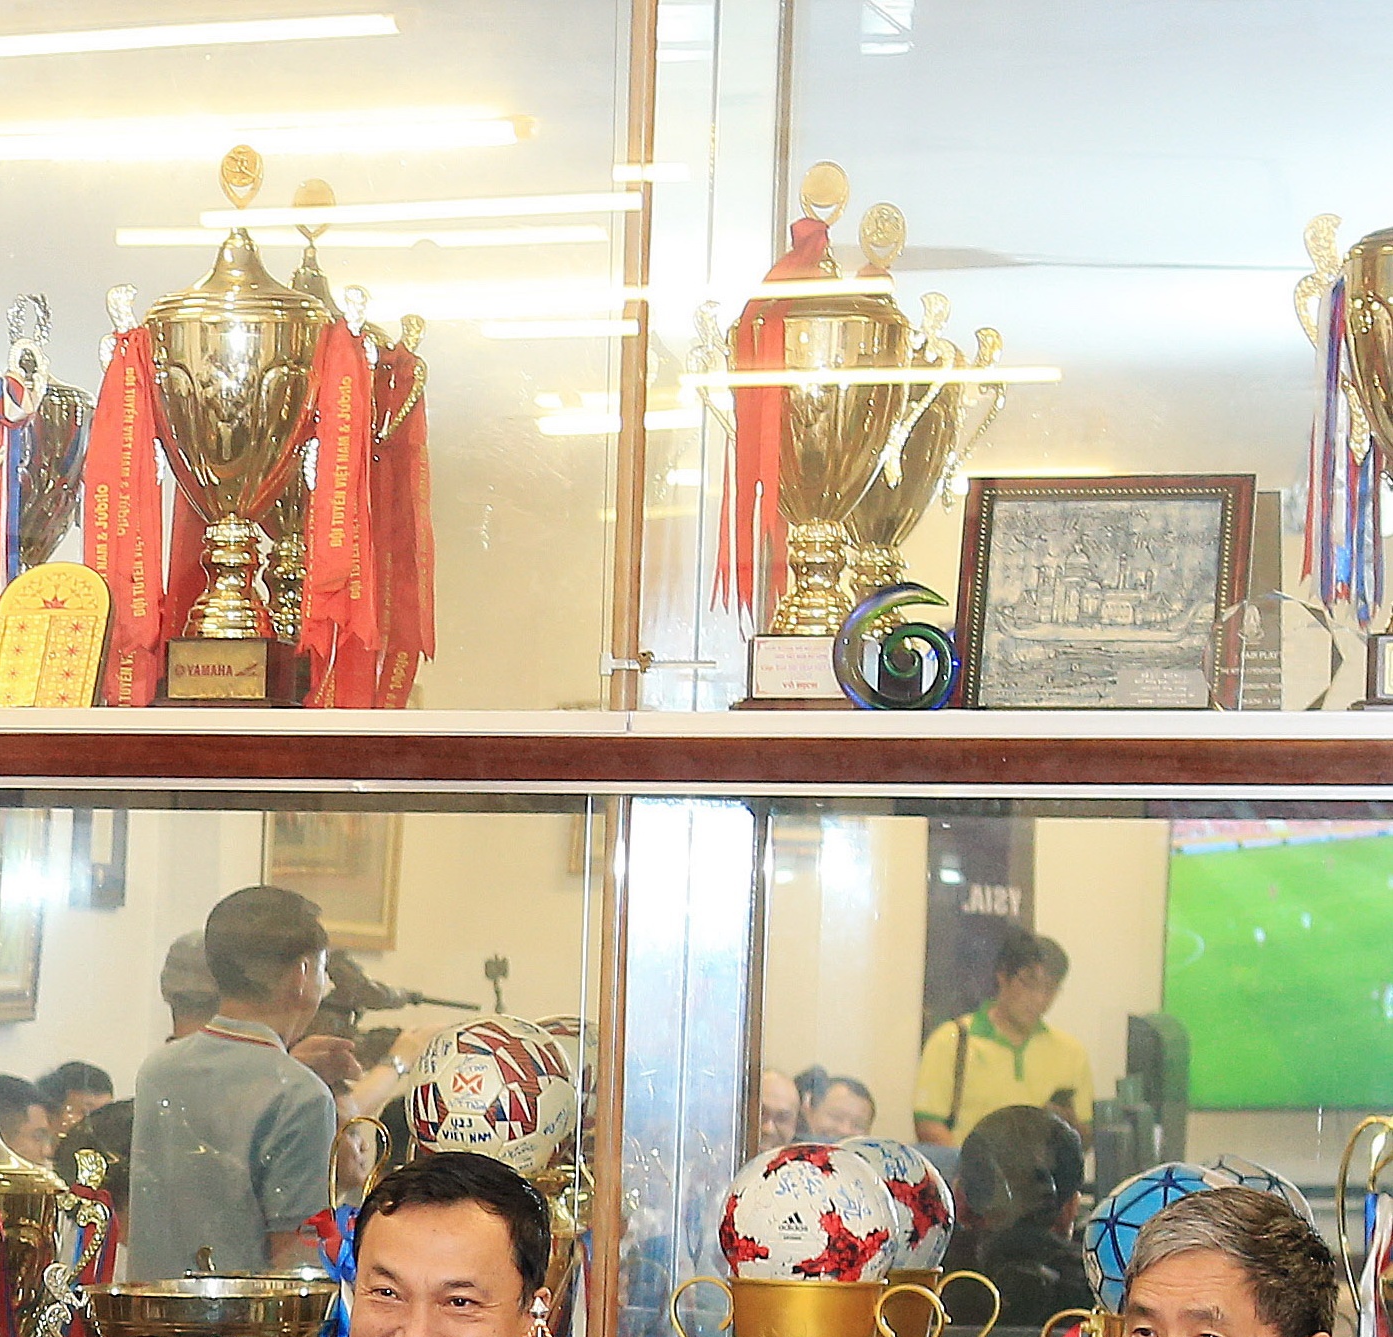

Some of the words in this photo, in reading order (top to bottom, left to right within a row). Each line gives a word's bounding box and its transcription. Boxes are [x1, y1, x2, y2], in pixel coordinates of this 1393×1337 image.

[187, 664, 233, 676] YAMAHA
[450, 1117, 473, 1130] U23
[469, 1130, 492, 1144] NAM
